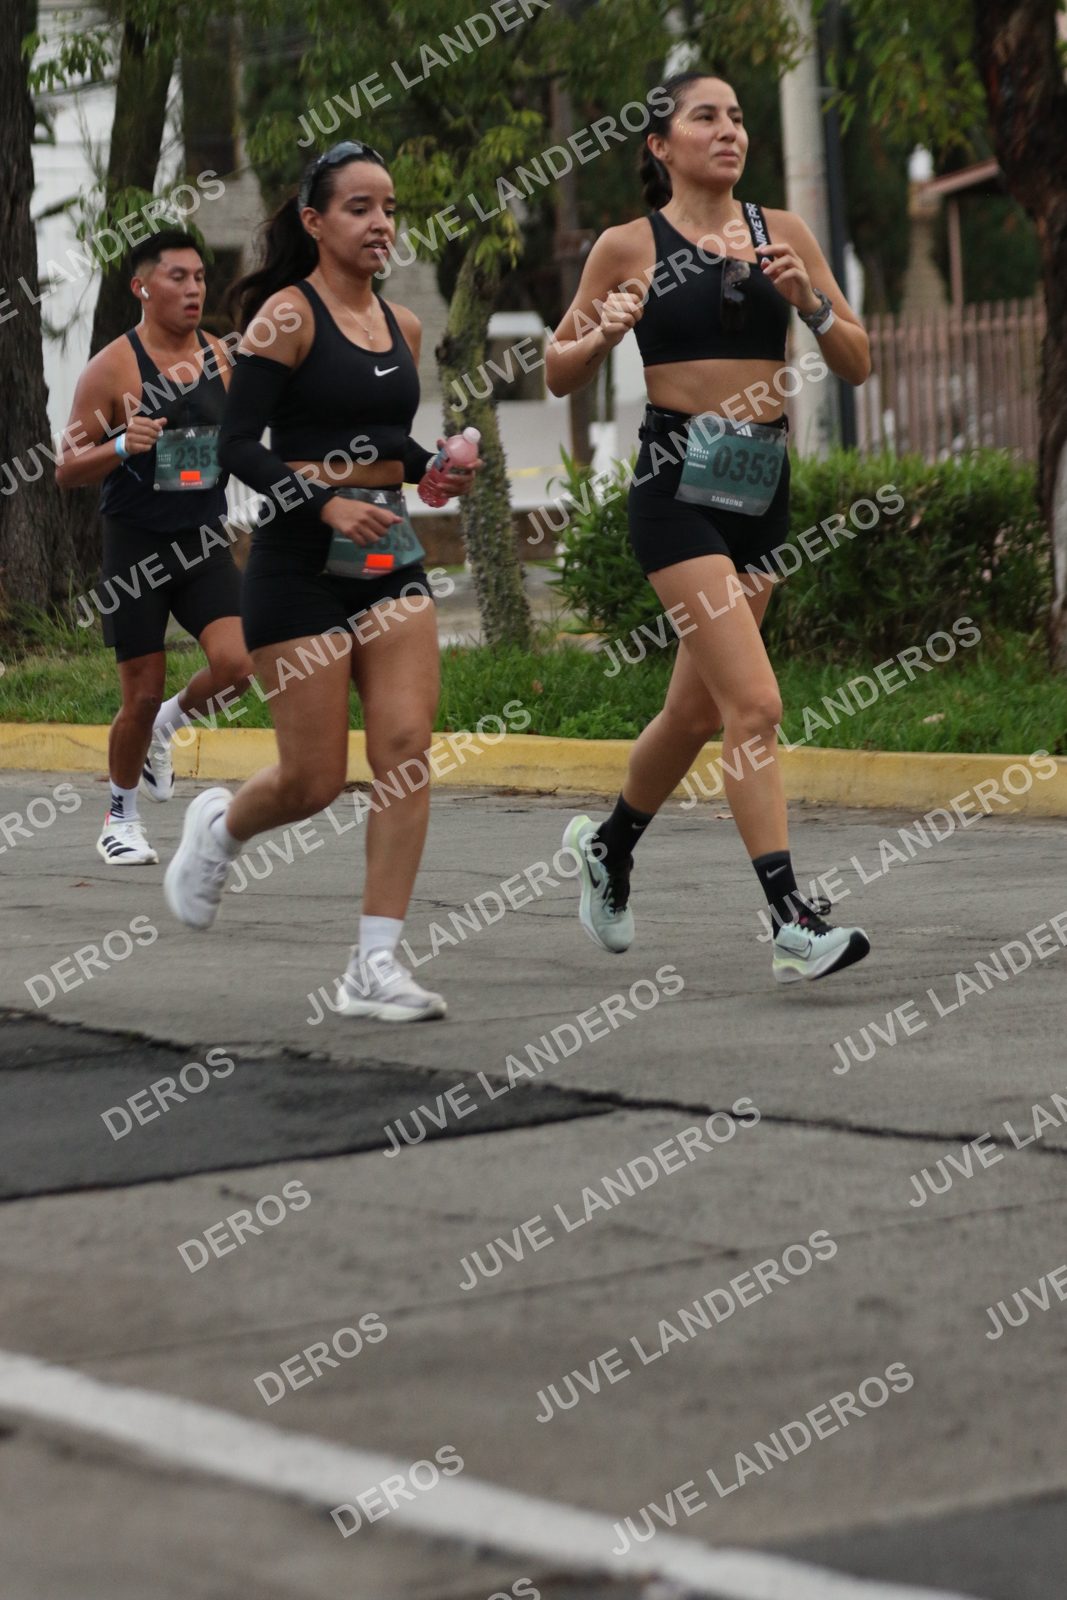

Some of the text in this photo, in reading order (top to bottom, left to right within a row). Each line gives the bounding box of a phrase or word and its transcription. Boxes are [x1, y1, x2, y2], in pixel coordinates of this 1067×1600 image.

[751, 217, 768, 250] NIKE
[711, 444, 779, 487] 0353
[711, 495, 744, 507] SAMSUNG
